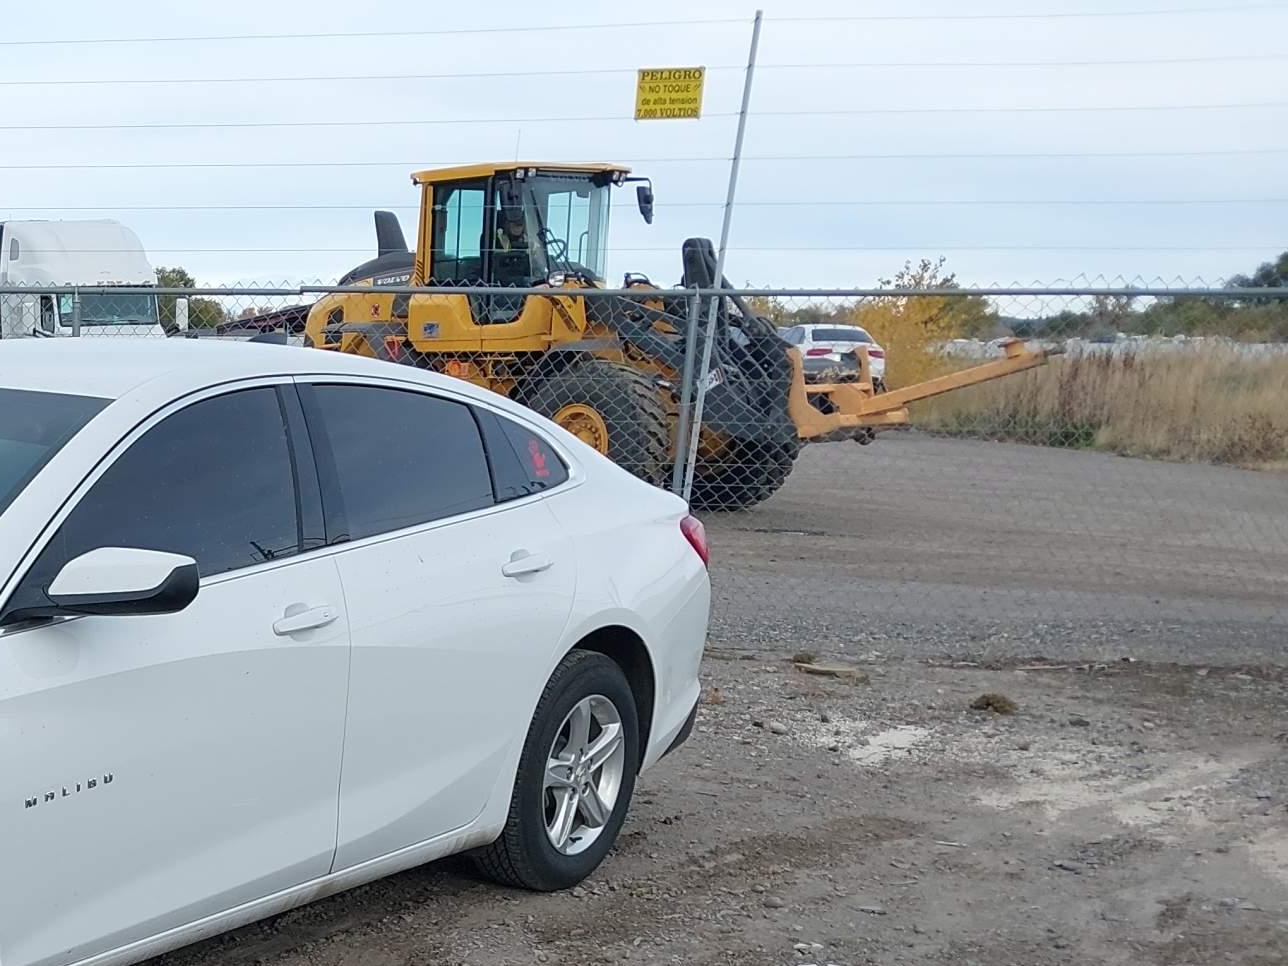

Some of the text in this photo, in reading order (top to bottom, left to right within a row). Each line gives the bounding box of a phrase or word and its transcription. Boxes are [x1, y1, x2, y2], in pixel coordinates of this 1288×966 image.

[641, 70, 702, 80] PELIGRO
[648, 83, 692, 94] NO TOQUE
[641, 97, 651, 106] de
[659, 107, 698, 118] VOLTIOS
[377, 275, 410, 284] VOLVO
[24, 772, 114, 809] MALIBU
